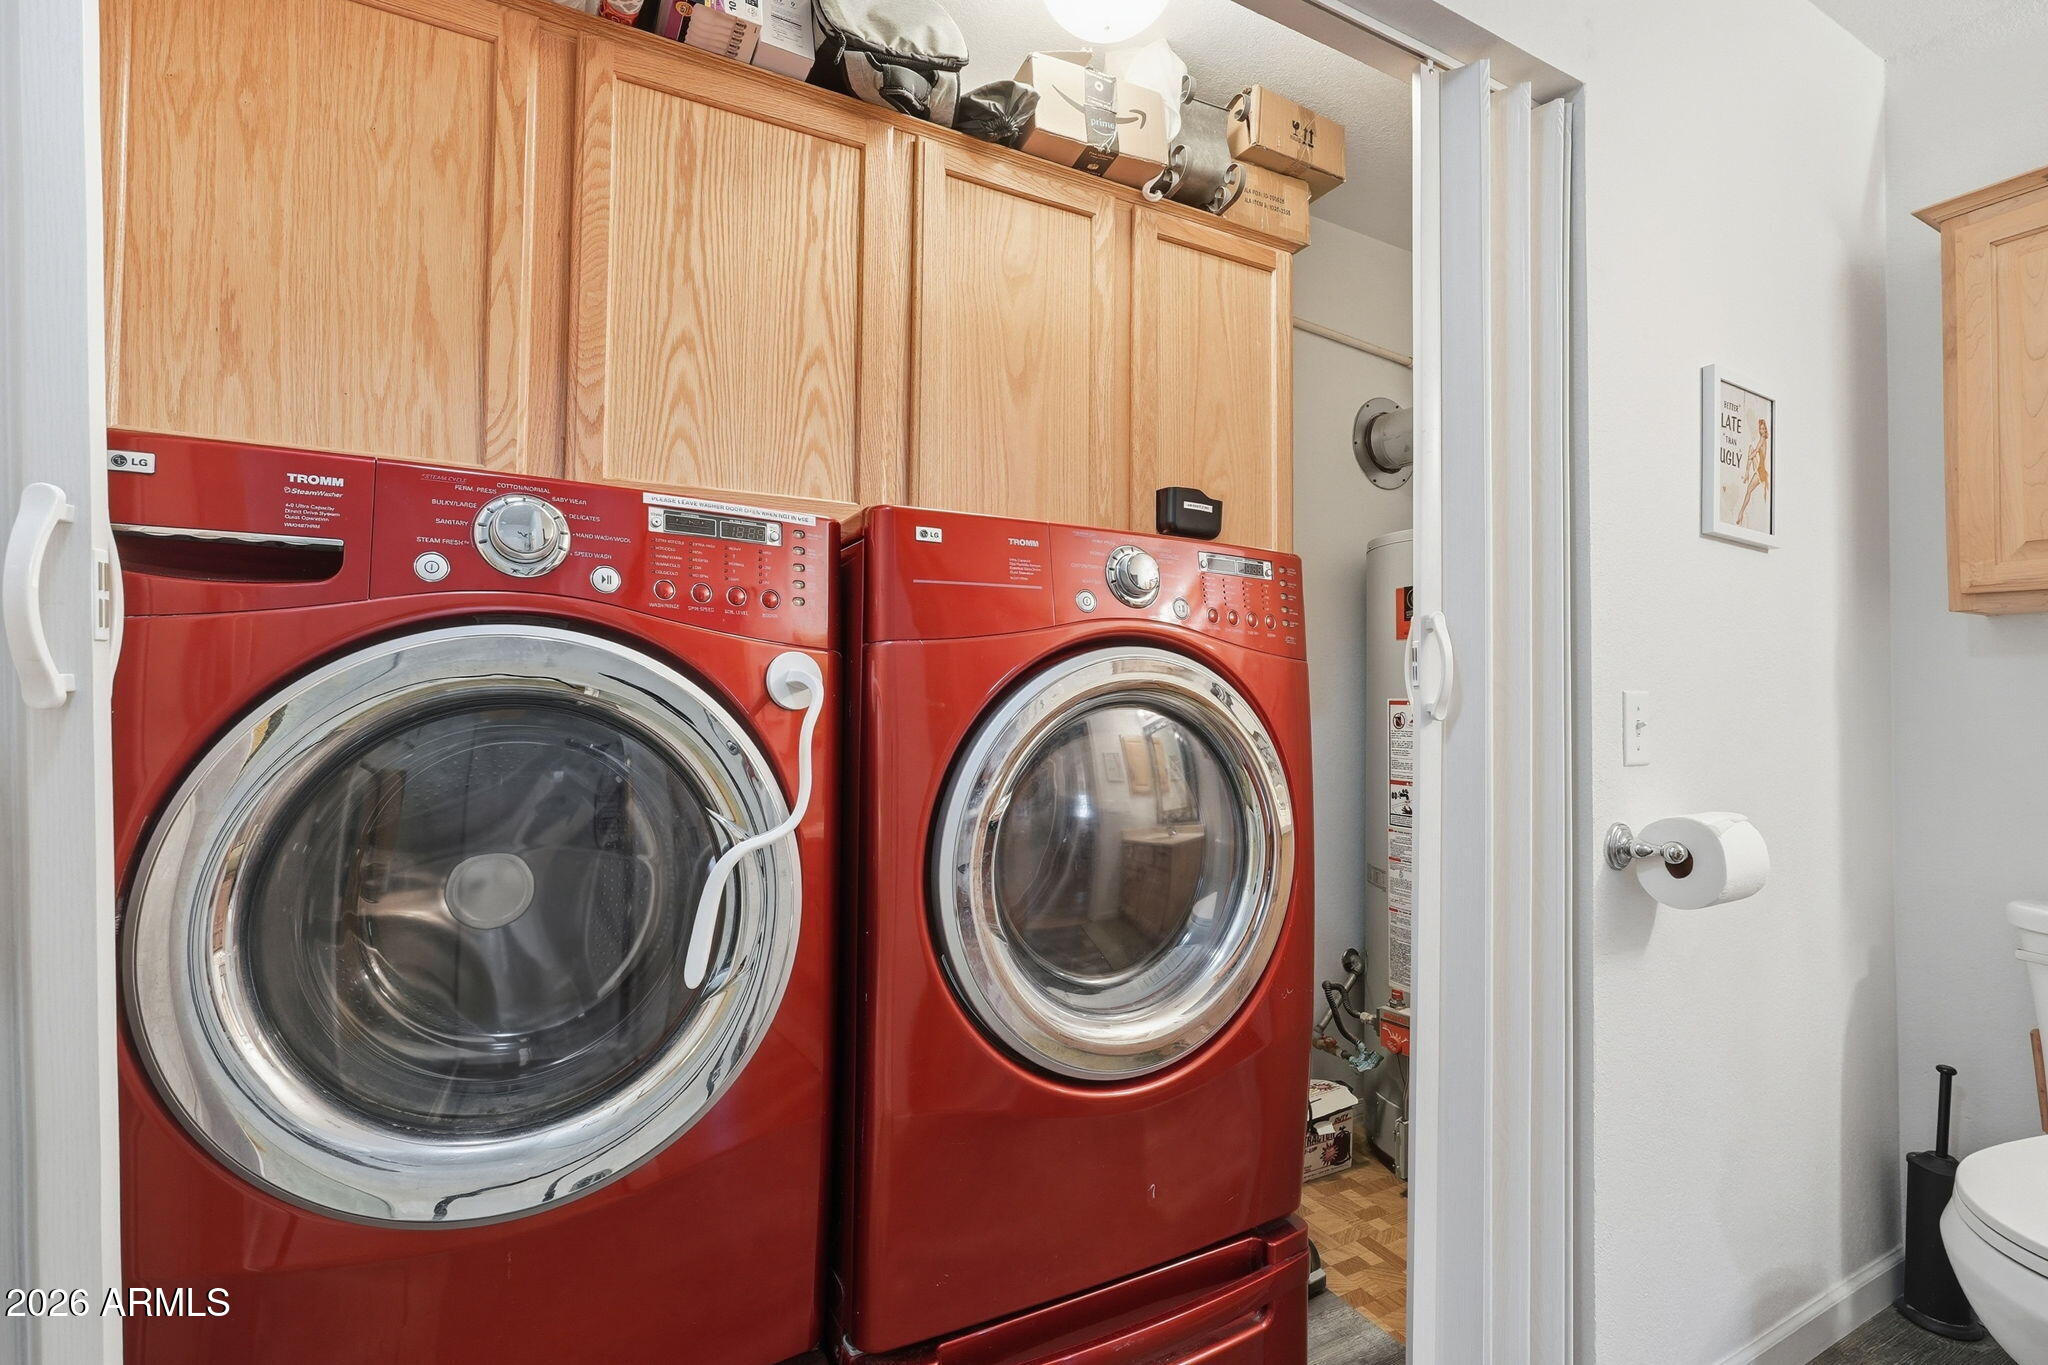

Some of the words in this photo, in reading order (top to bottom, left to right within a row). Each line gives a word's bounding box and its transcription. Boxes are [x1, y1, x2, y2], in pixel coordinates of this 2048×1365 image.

[1090, 117, 1116, 130] prime
[1723, 400, 1739, 412] BETTER
[1721, 412, 1742, 433] LATE
[1720, 447, 1743, 468] UGLY
[286, 472, 345, 487] TROMM
[476, 486, 497, 494] PRESS
[496, 482, 551, 494] COTTON/NORMAL
[431, 498, 478, 509] BULKY/LARGE
[569, 498, 587, 506] WEAR
[651, 496, 677, 504] PLEASE
[677, 499, 698, 507] LEAVE
[699, 502, 725, 510] WASHER
[435, 517, 469, 526] SANITARY
[569, 513, 600, 522] DELICATES
[416, 536, 441, 544] STEAM
[1008, 537, 1040, 547] TROMM
[594, 552, 612, 560] WASH
